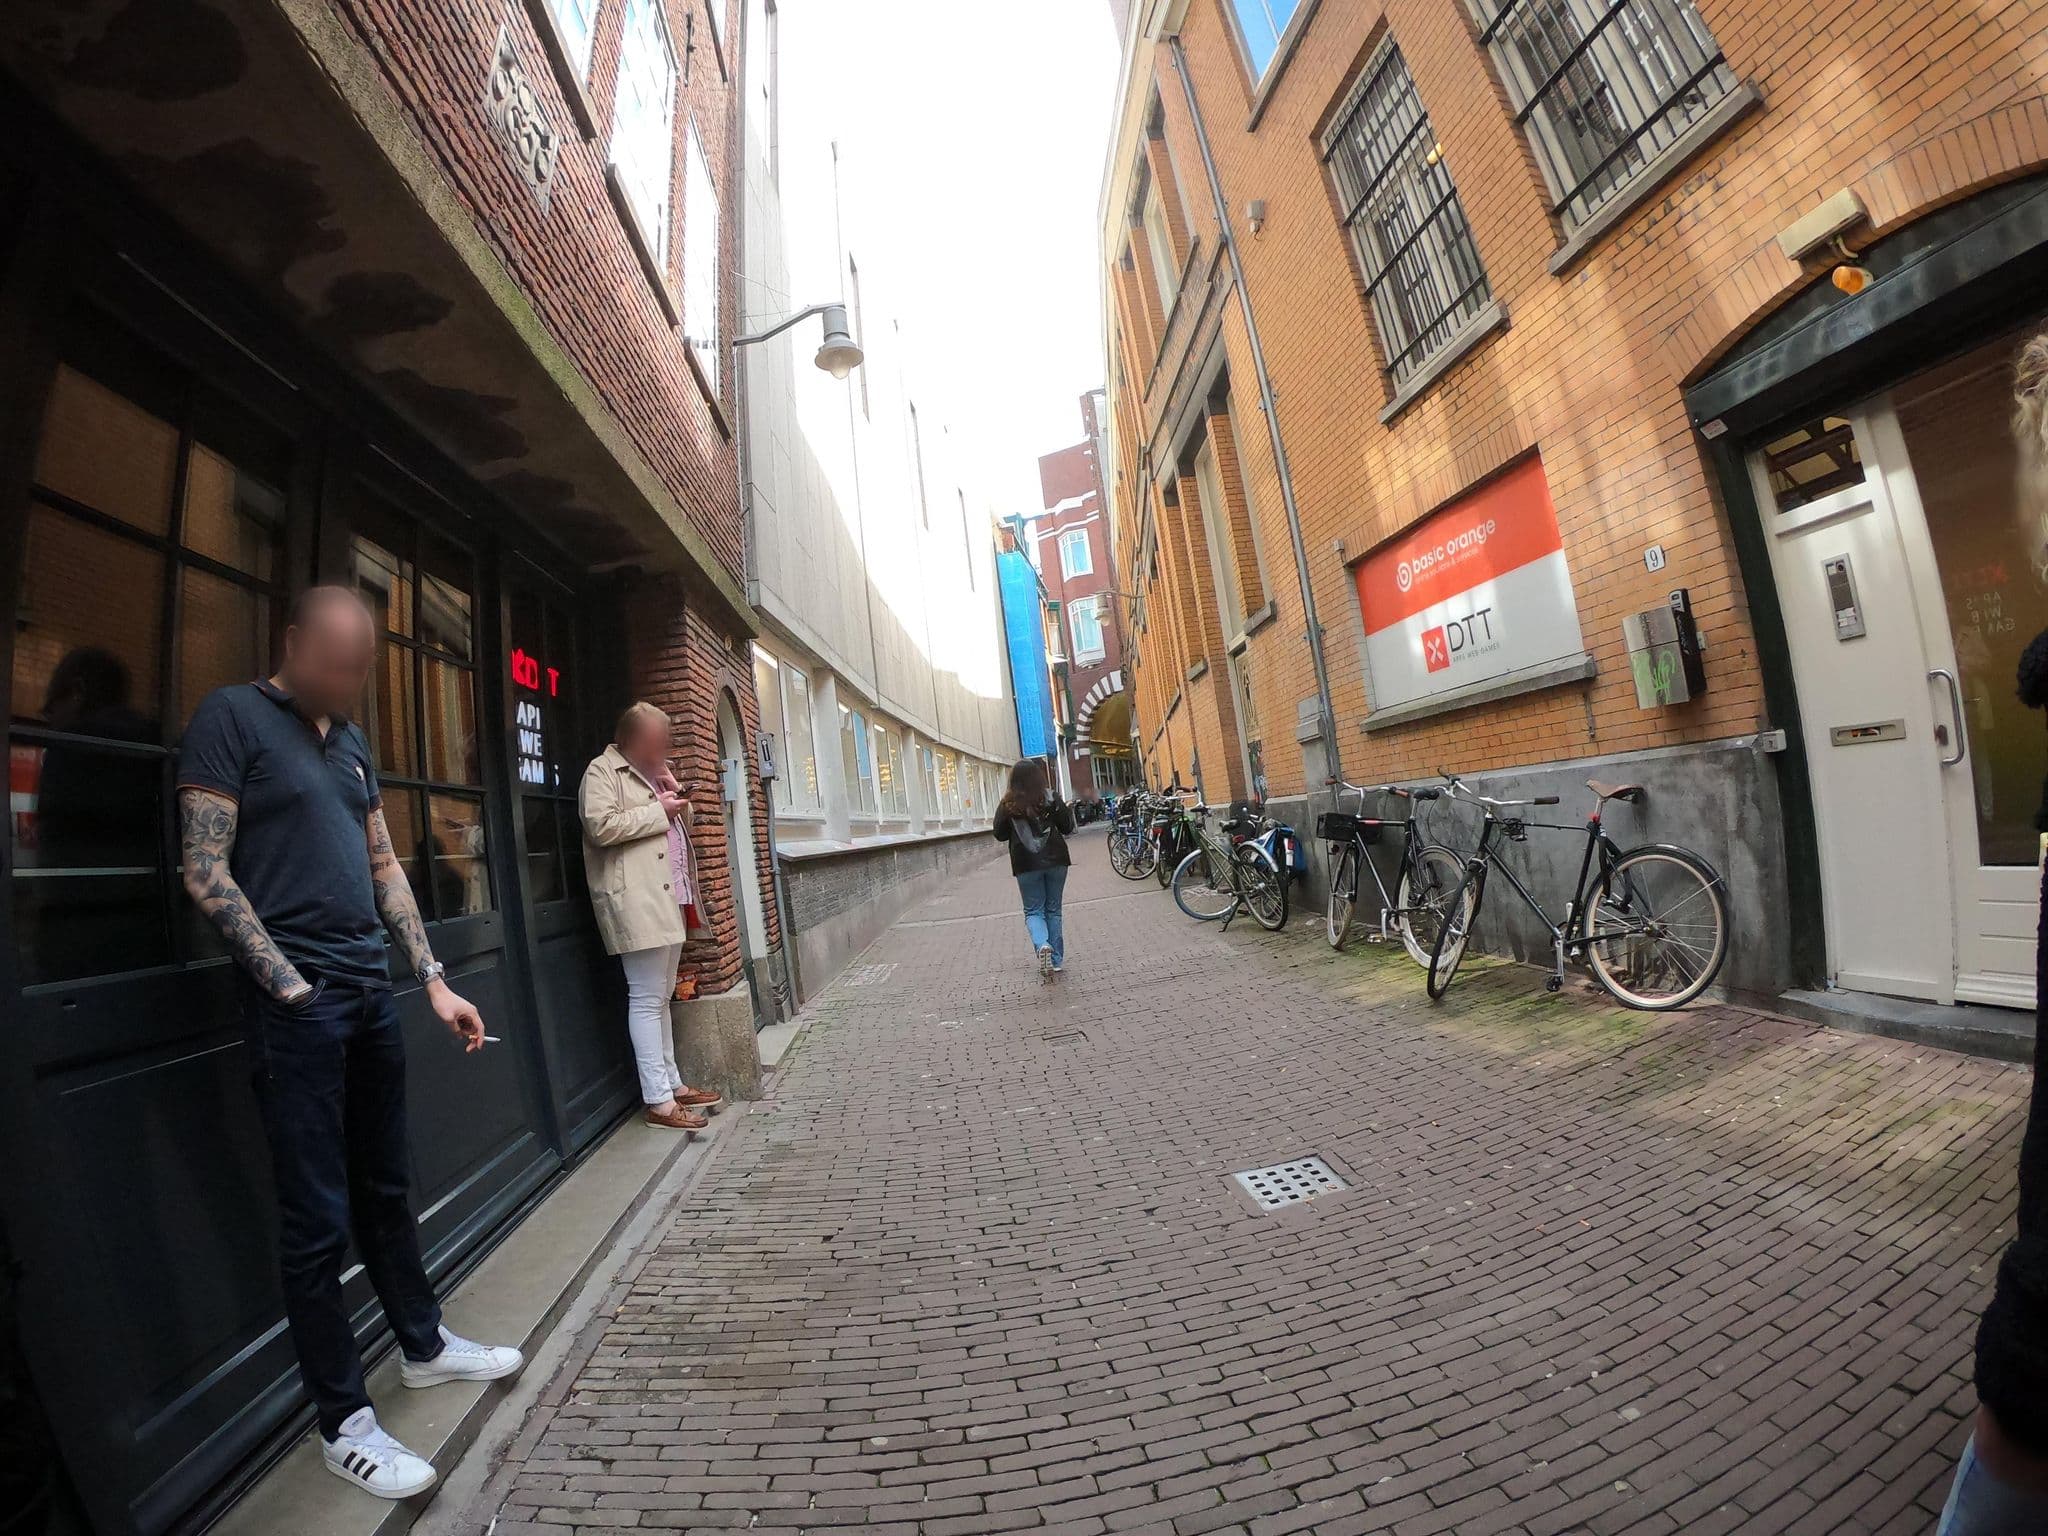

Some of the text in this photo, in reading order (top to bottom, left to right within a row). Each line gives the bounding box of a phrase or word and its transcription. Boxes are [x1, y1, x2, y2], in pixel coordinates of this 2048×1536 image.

[1412, 546, 1445, 574] basic
[1446, 519, 1496, 555] orange
[1649, 549, 1659, 568] 9
[1447, 607, 1491, 652] DTT
